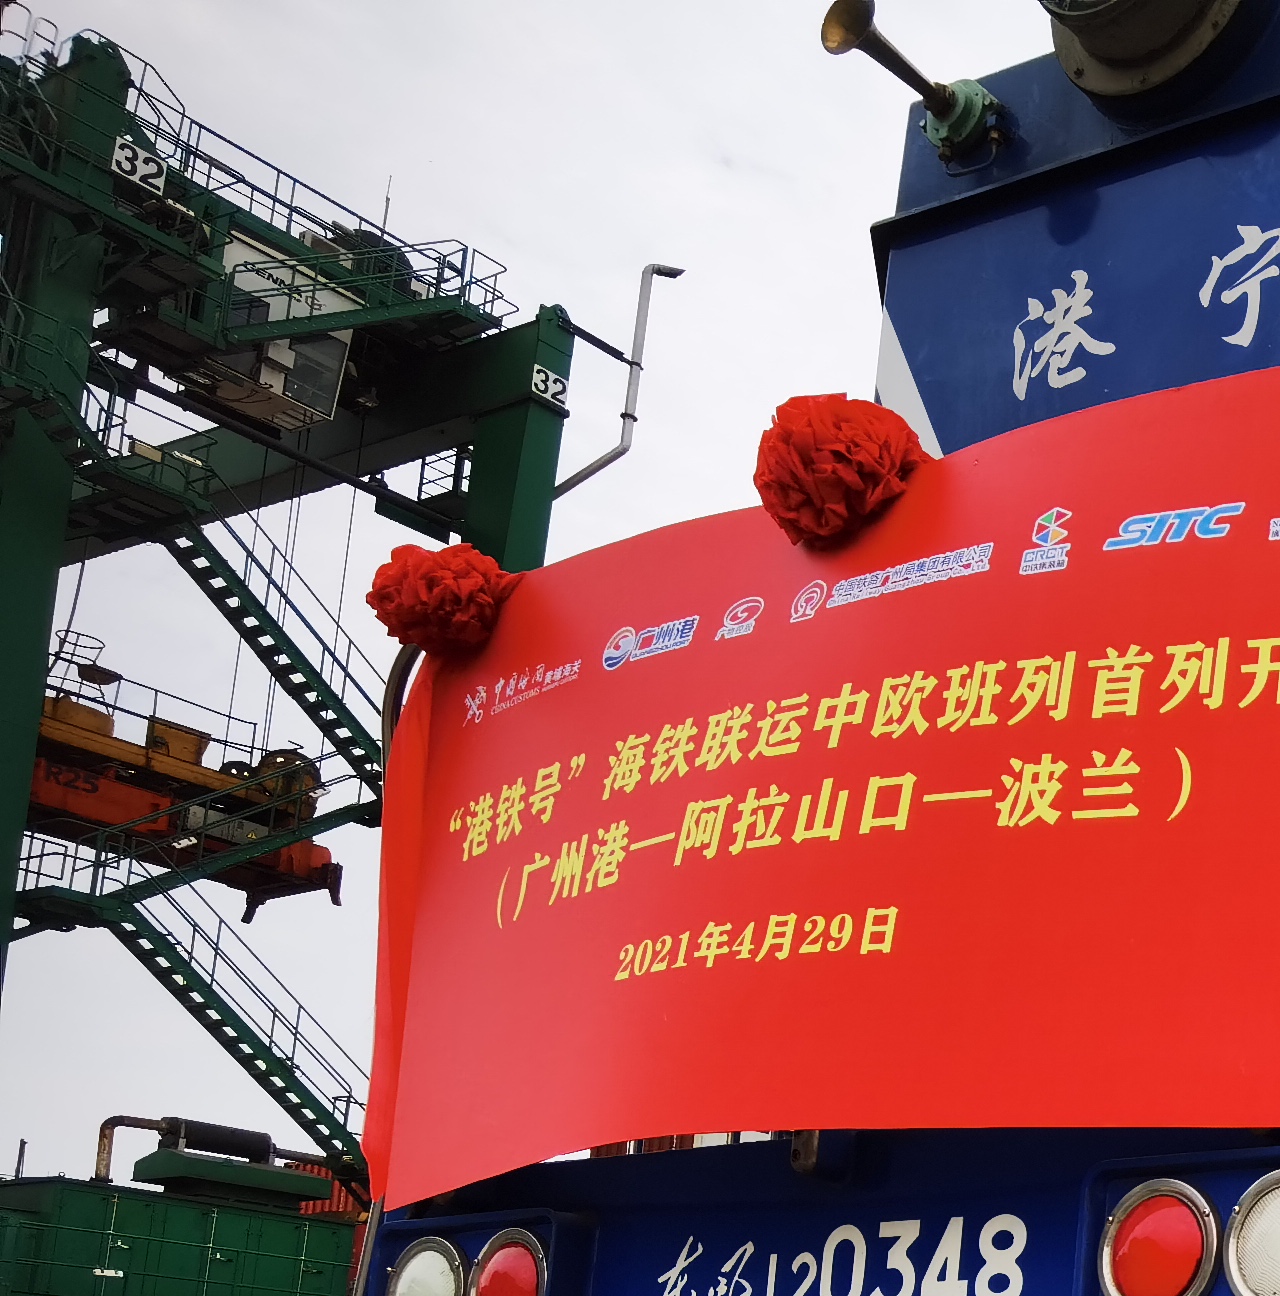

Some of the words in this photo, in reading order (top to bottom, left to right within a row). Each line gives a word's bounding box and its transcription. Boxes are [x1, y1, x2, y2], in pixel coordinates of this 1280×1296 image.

[115, 142, 165, 192] 32
[533, 368, 567, 406] 32
[1103, 502, 1245, 550] SITC
[1023, 545, 1069, 563] CRCT
[635, 616, 698, 651] 广州港
[613, 905, 900, 982] 2021年4月29日
